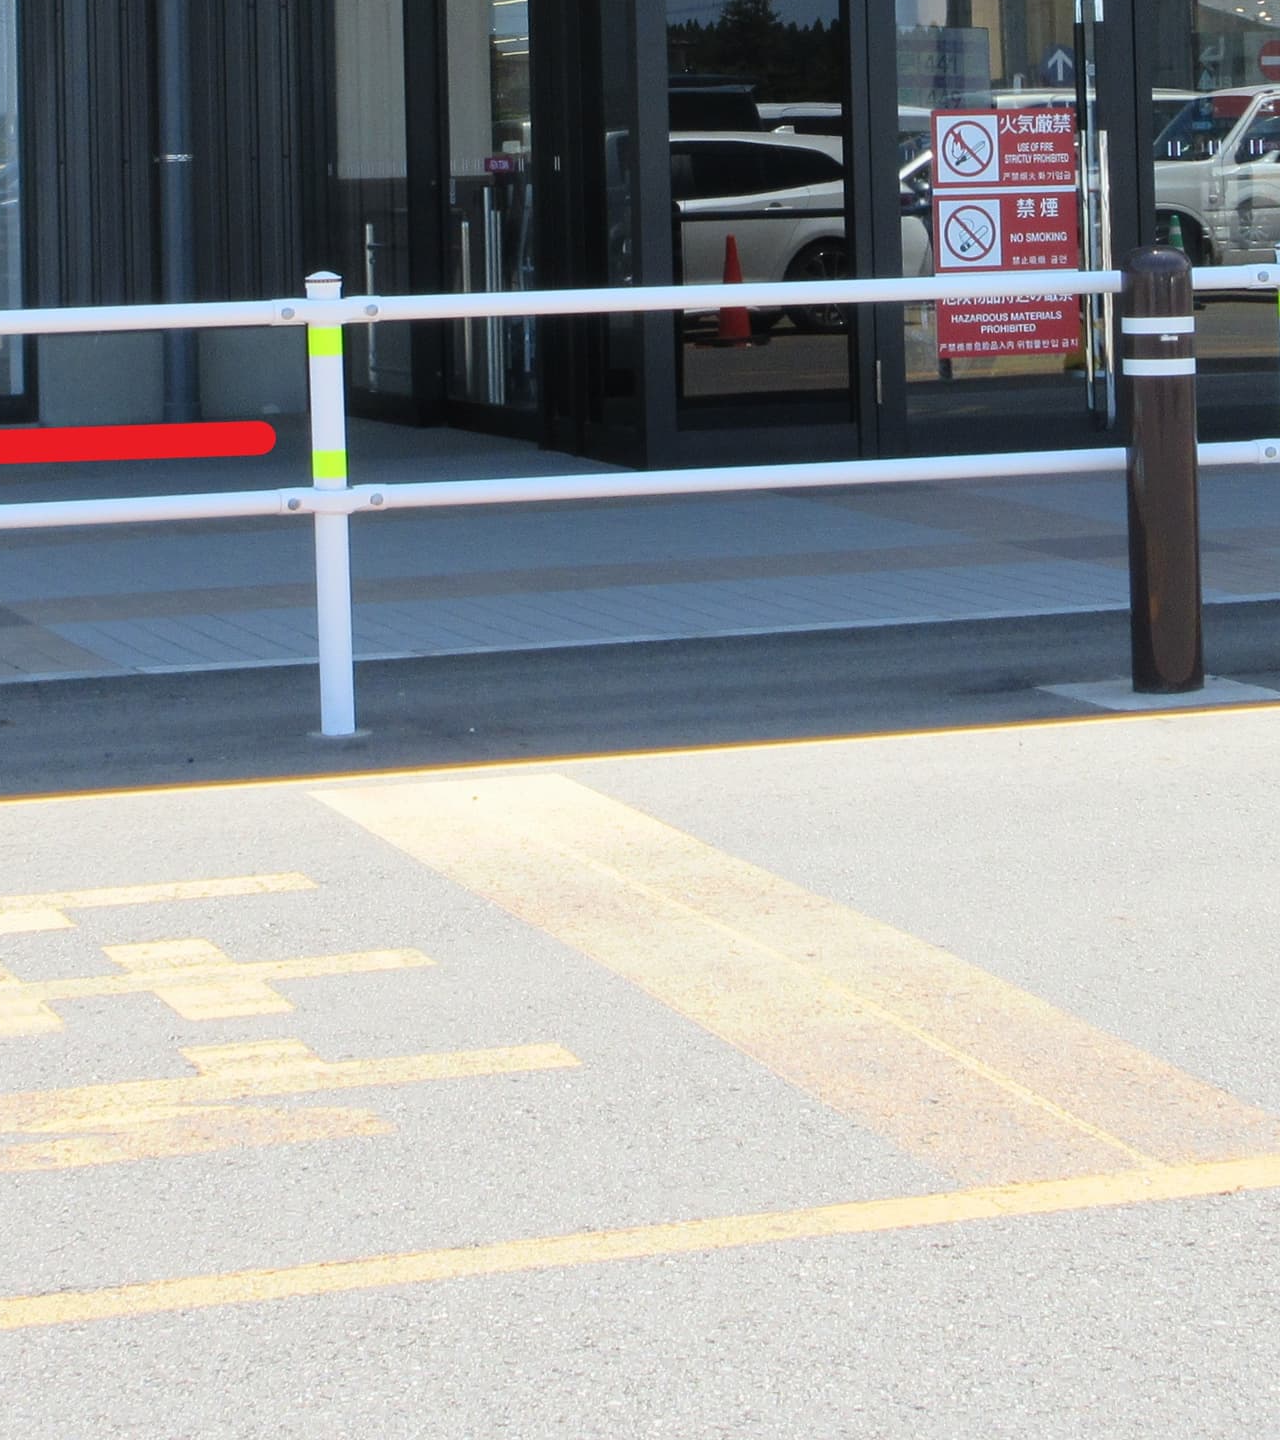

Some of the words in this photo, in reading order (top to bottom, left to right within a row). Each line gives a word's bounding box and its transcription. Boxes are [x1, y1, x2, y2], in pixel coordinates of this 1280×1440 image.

[999, 113, 1072, 135] 火気厳禁
[1016, 142, 1030, 152] USE
[1004, 154, 1032, 164] STRICTLY
[1033, 153, 1070, 164] PROHIBITED
[1009, 233, 1024, 243] NO
[1025, 231, 1068, 242] SMOKING
[951, 313, 1009, 323] HAZARDOUS
[1010, 311, 1063, 321] MATERIALS
[980, 324, 1037, 334] PROHIBITED
